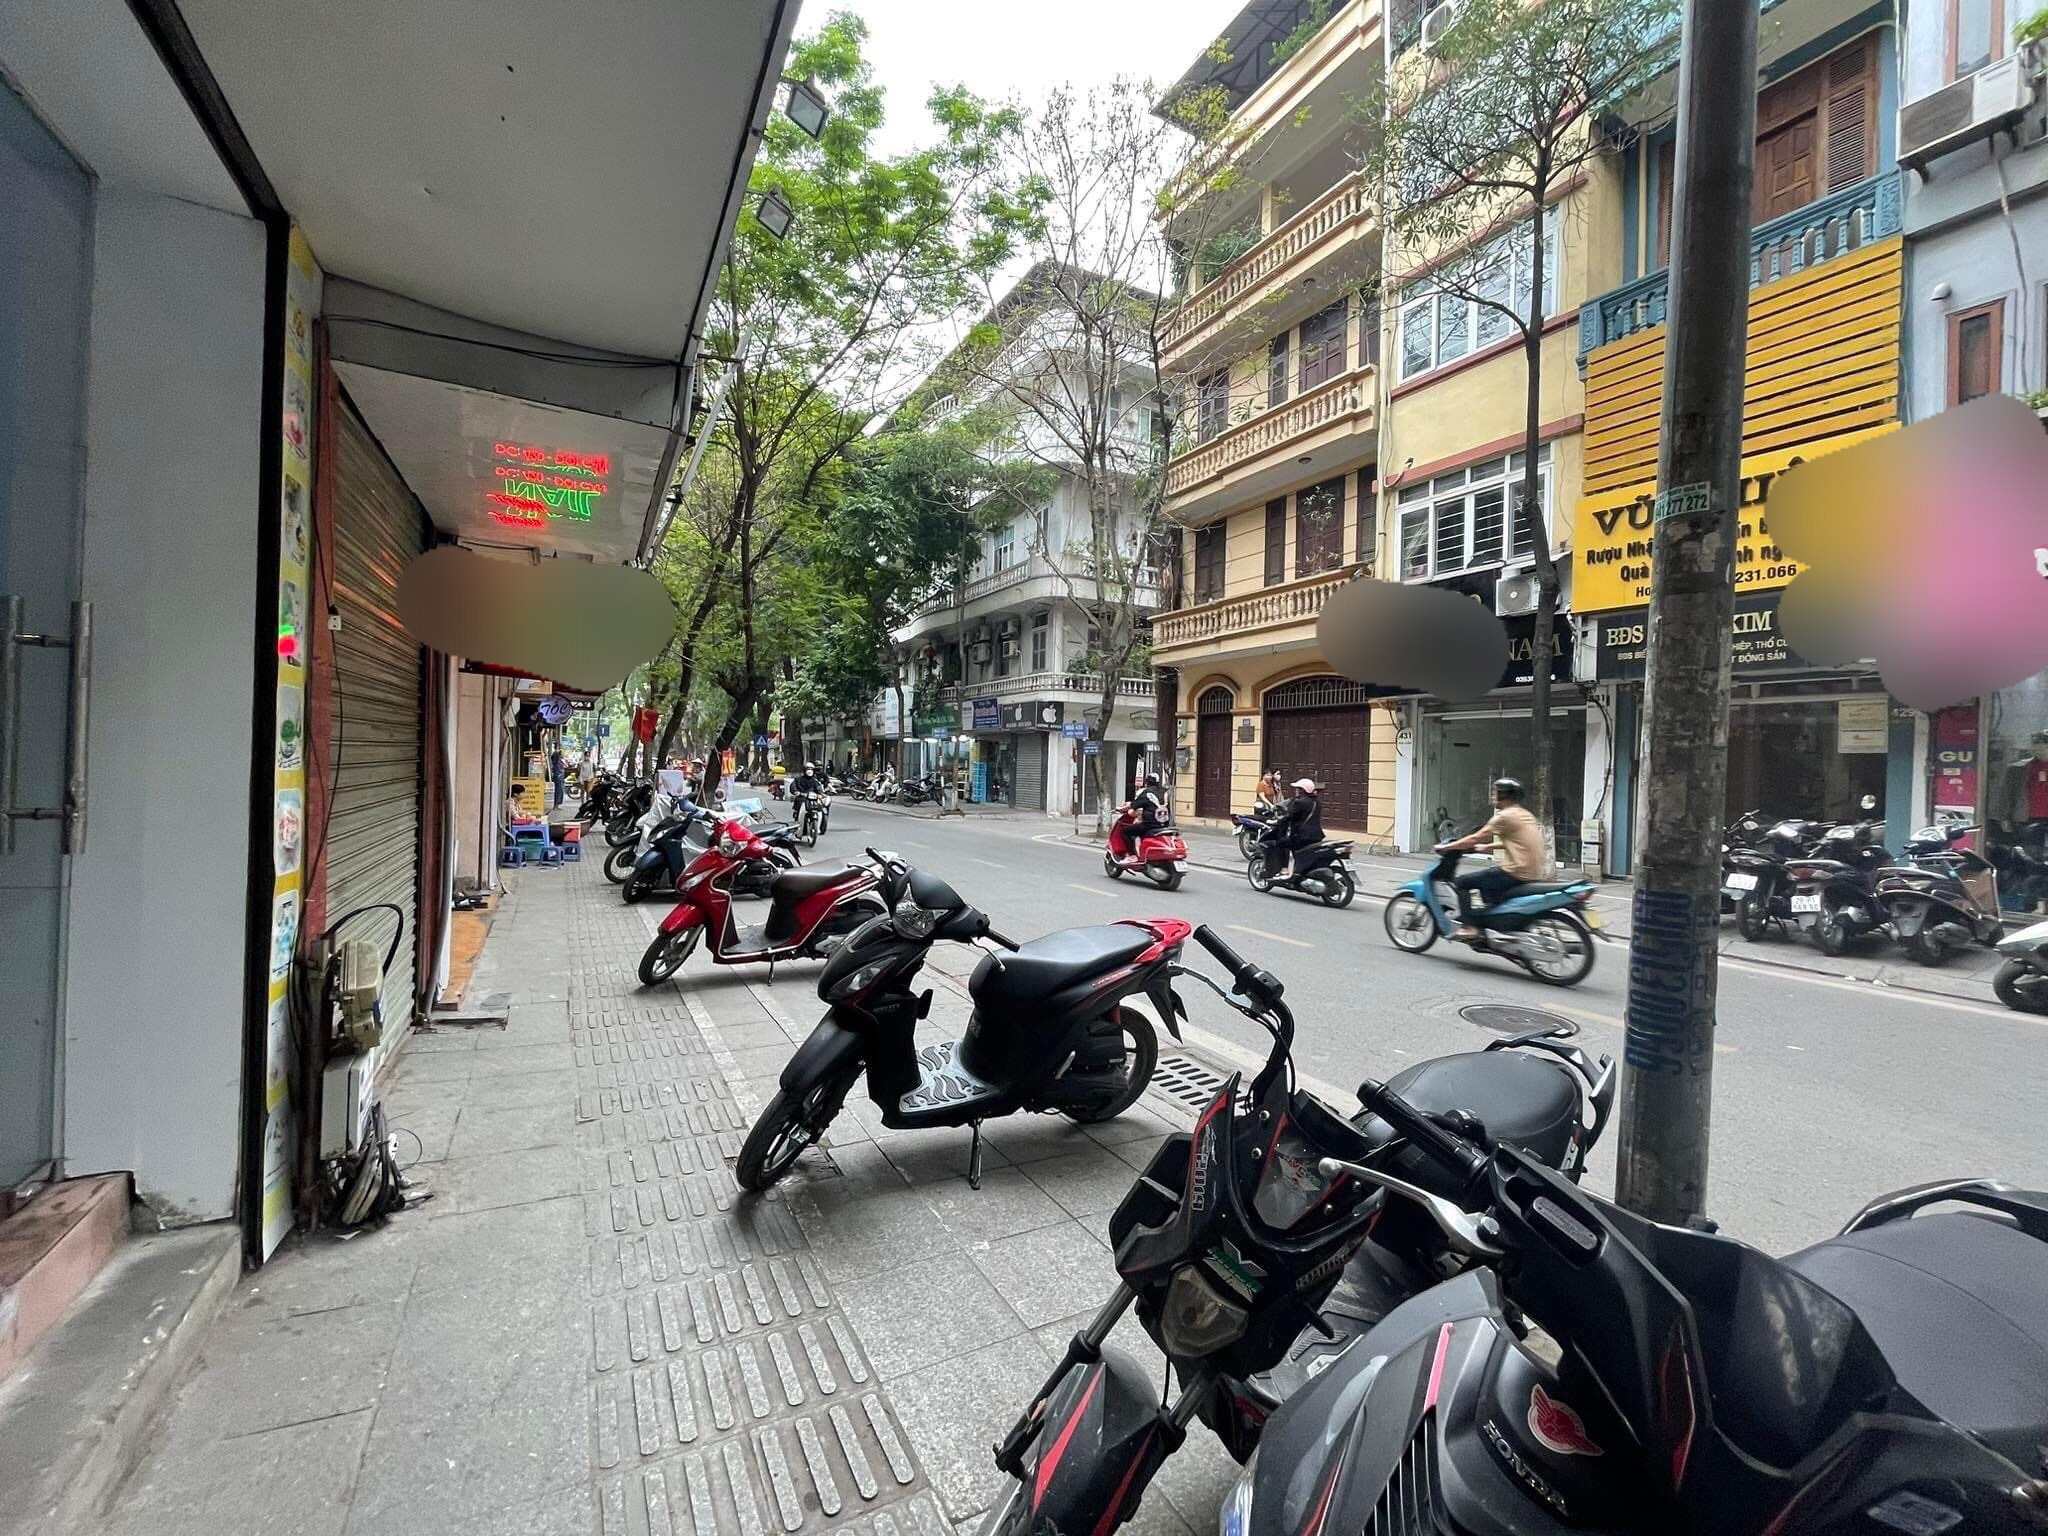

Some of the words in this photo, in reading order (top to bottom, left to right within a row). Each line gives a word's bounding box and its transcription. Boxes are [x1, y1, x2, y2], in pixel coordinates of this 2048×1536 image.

[1587, 545, 1622, 566] Rượu
[1606, 624, 1645, 647] BĐS
[1482, 1418, 1570, 1518] HONDA
